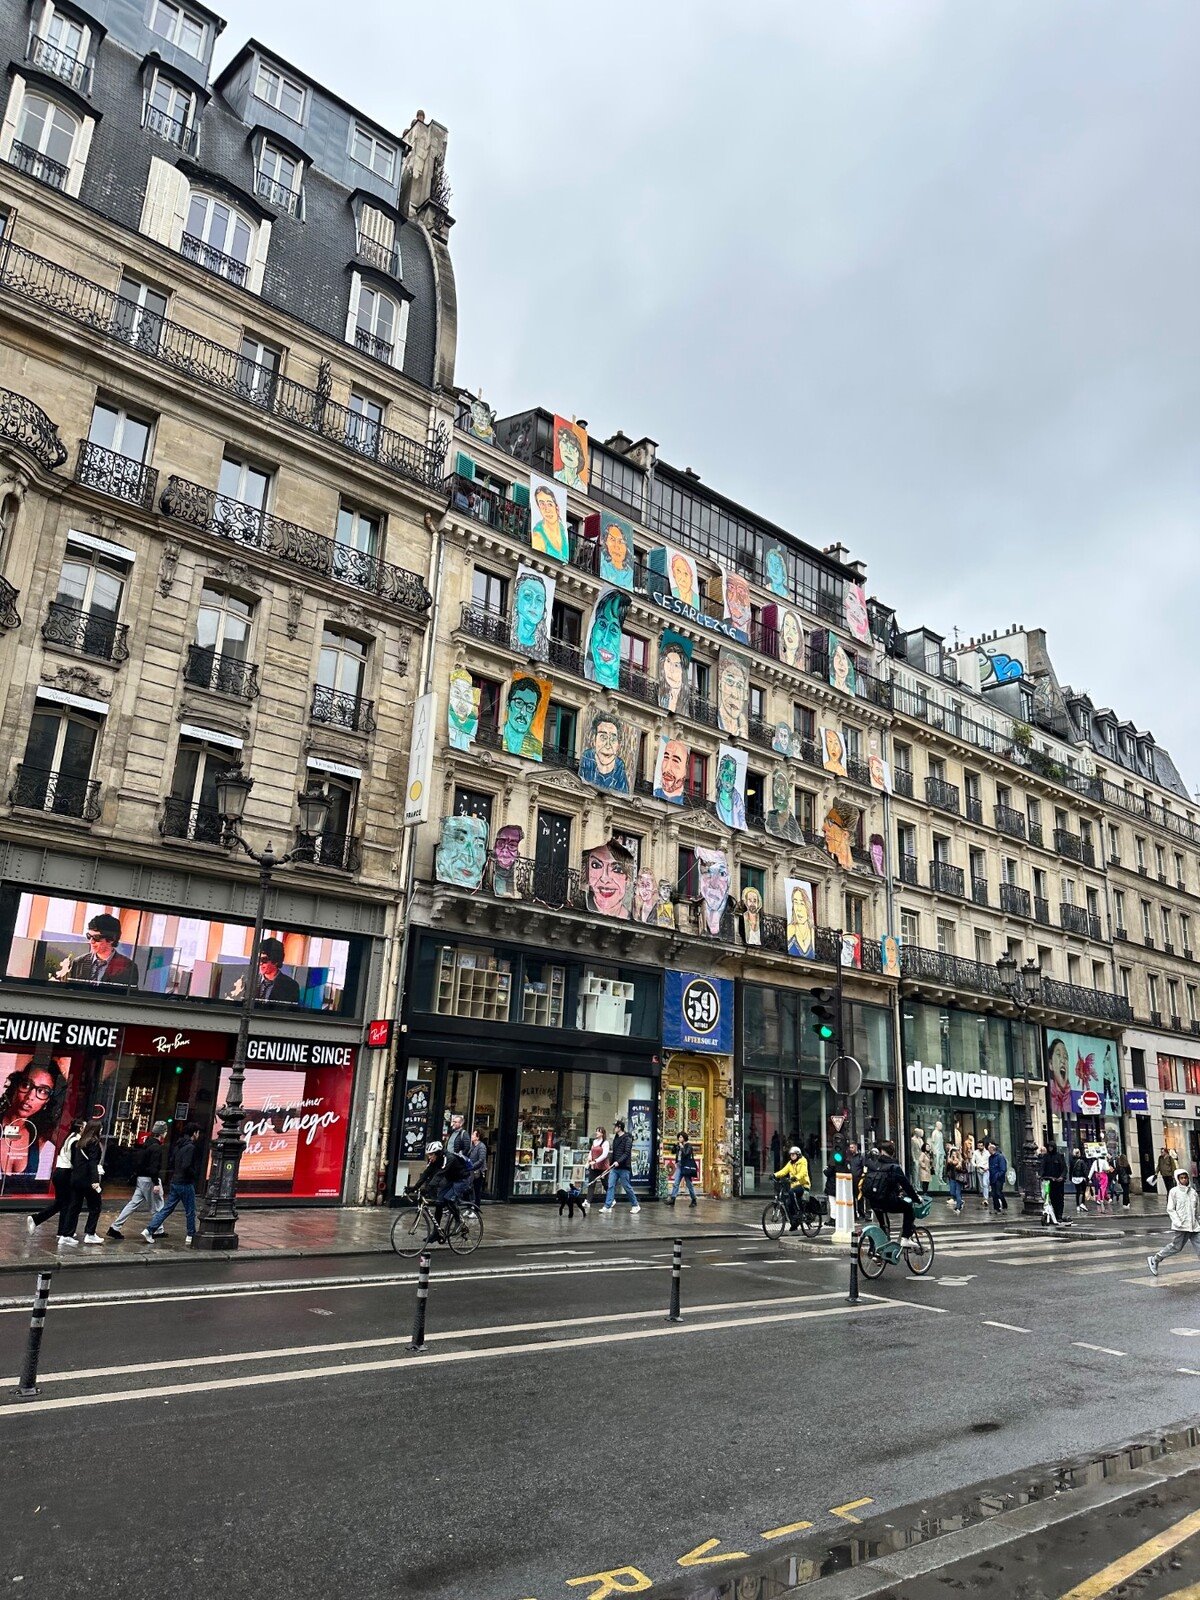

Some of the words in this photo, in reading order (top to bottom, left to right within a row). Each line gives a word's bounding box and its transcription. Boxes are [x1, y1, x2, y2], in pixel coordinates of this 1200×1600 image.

[405, 808, 422, 819] FRANCE
[687, 989, 717, 1022] 59
[65, 1024, 119, 1048] SINCE
[683, 1035, 719, 1046] AFTERSQUAT
[247, 1040, 309, 1063] GENUINE
[311, 1045, 352, 1066] SINCE
[906, 1060, 1013, 1101] delaveine
[260, 1093, 282, 1113] This
[286, 1096, 324, 1111] summer
[243, 1116, 275, 1141] go
[282, 1111, 340, 1145] mega
[269, 1137, 288, 1150] in
[523, 1497, 875, 1600] LIVR
